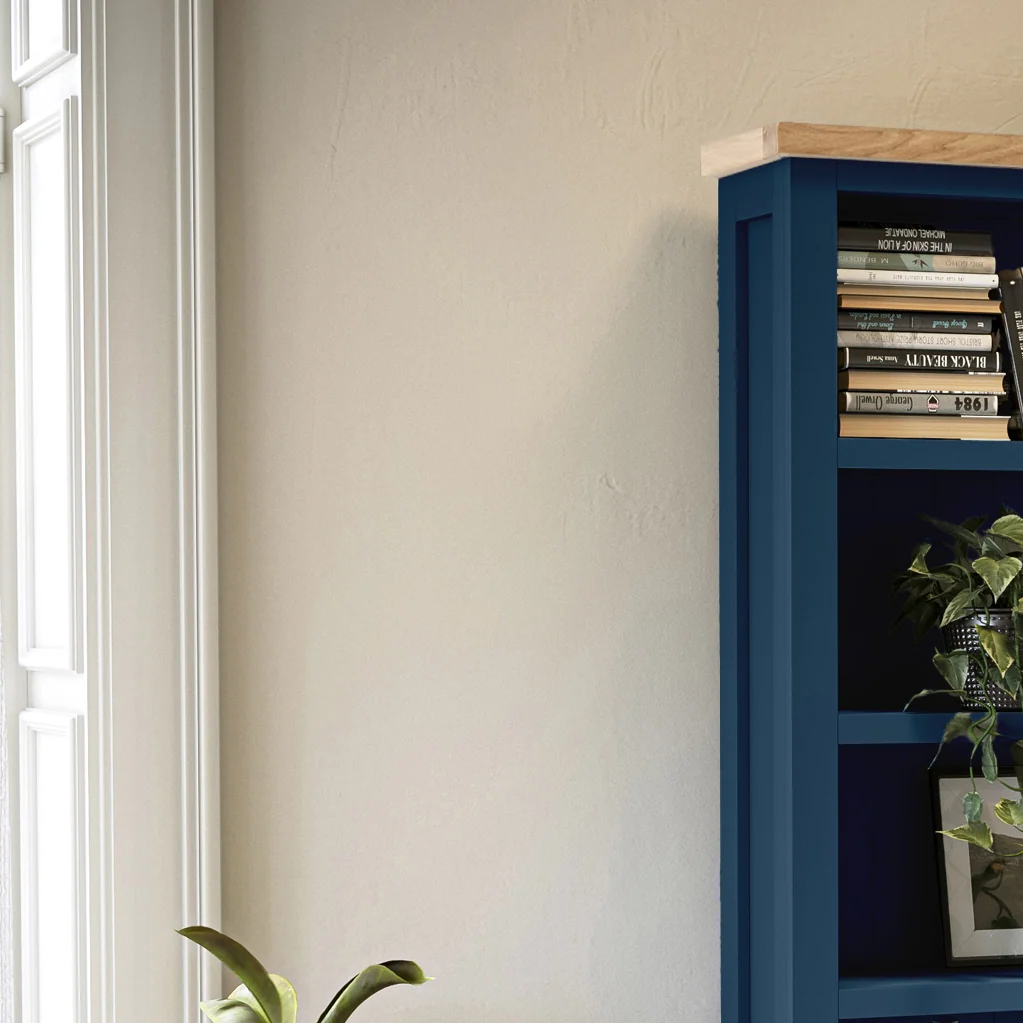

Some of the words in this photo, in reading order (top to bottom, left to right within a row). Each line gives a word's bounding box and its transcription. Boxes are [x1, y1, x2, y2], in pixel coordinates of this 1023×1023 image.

[885, 227, 918, 237] ONDAATJE
[918, 229, 946, 239] MICHAEL
[877, 239, 896, 250] LION
[901, 240, 913, 250] OF
[912, 240, 929, 251] SKIN
[930, 242, 944, 252] THE
[944, 243, 952, 252] IN
[866, 355, 884, 363] Sewell
[904, 354, 948, 367] BEAUTY
[950, 355, 987, 369] BLACK
[855, 395, 883, 410] Orwell
[885, 393, 913, 411] George
[954, 396, 989, 411] 1984
